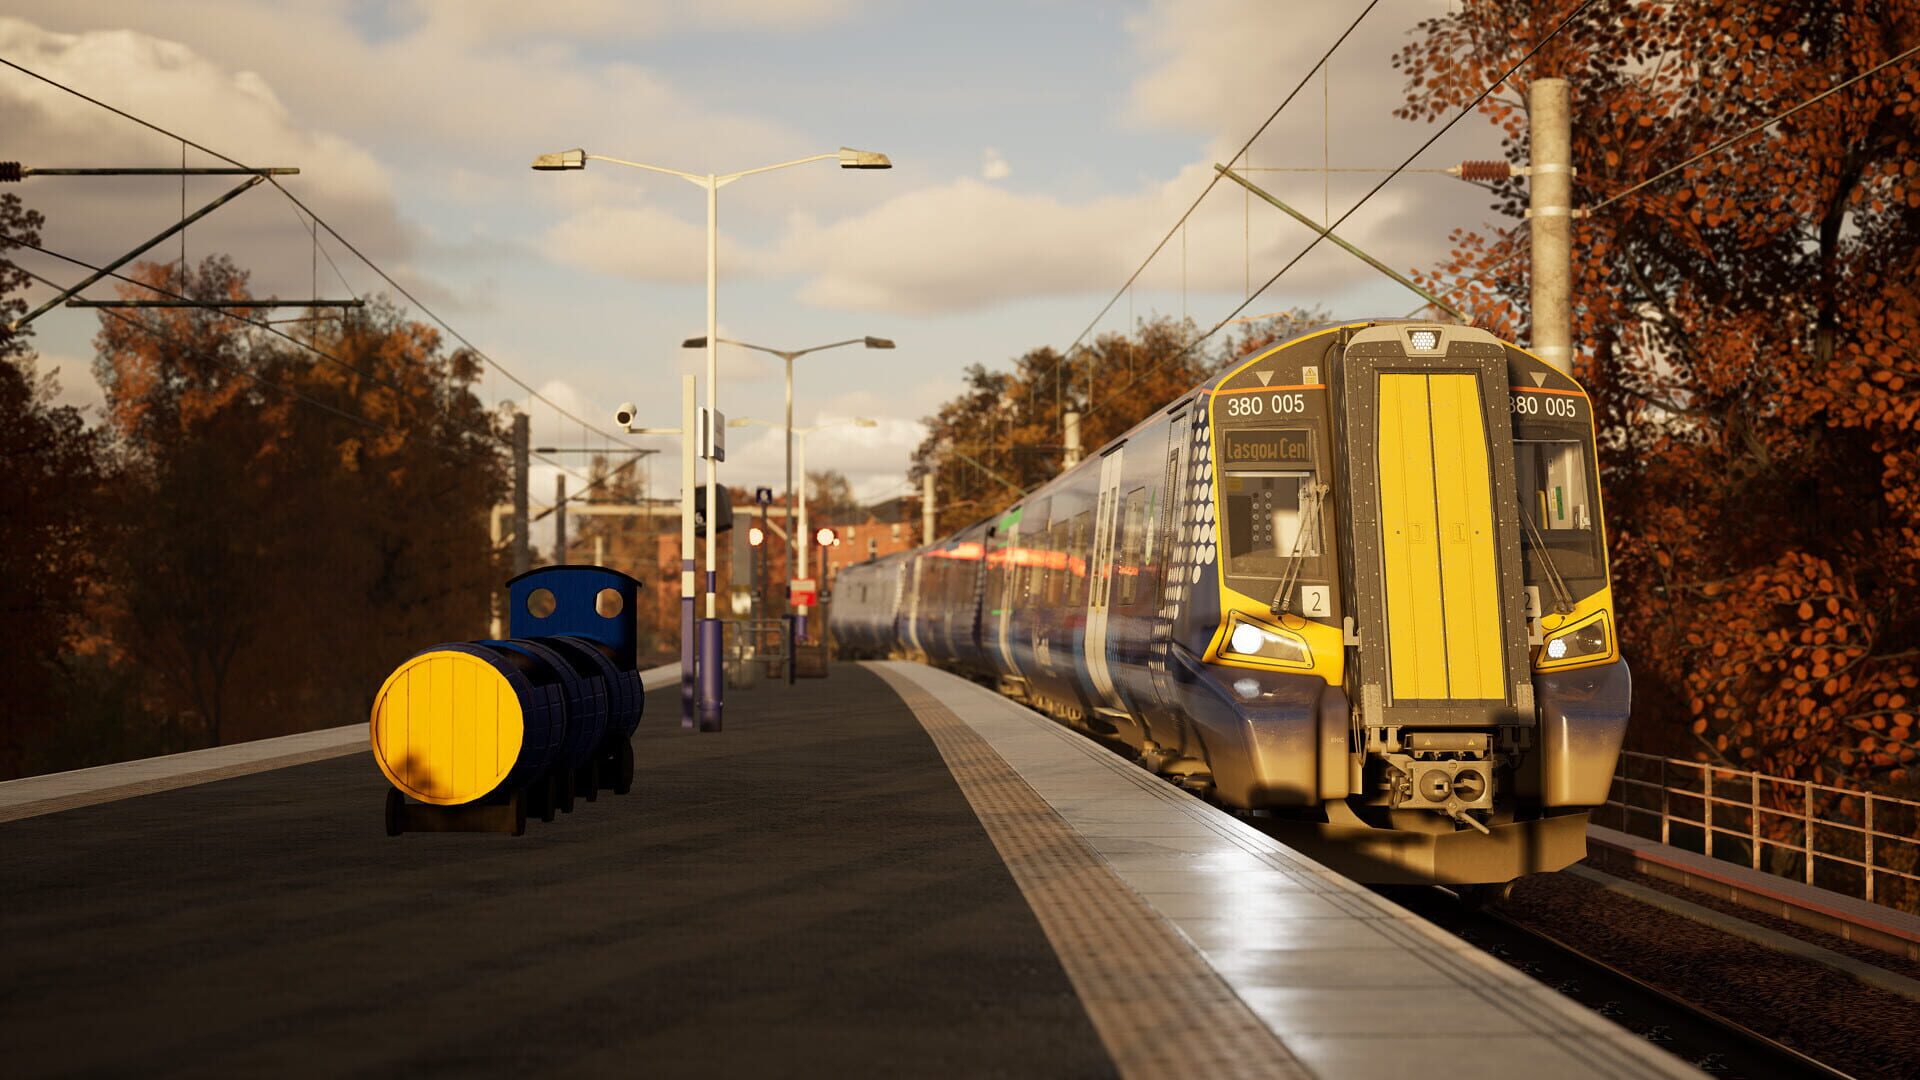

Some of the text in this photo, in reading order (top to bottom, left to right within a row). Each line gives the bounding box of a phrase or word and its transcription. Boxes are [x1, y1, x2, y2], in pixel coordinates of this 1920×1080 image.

[1228, 394, 1305, 416] 380 005
[1545, 397, 1576, 418] 005
[1311, 591, 1322, 612] 2
